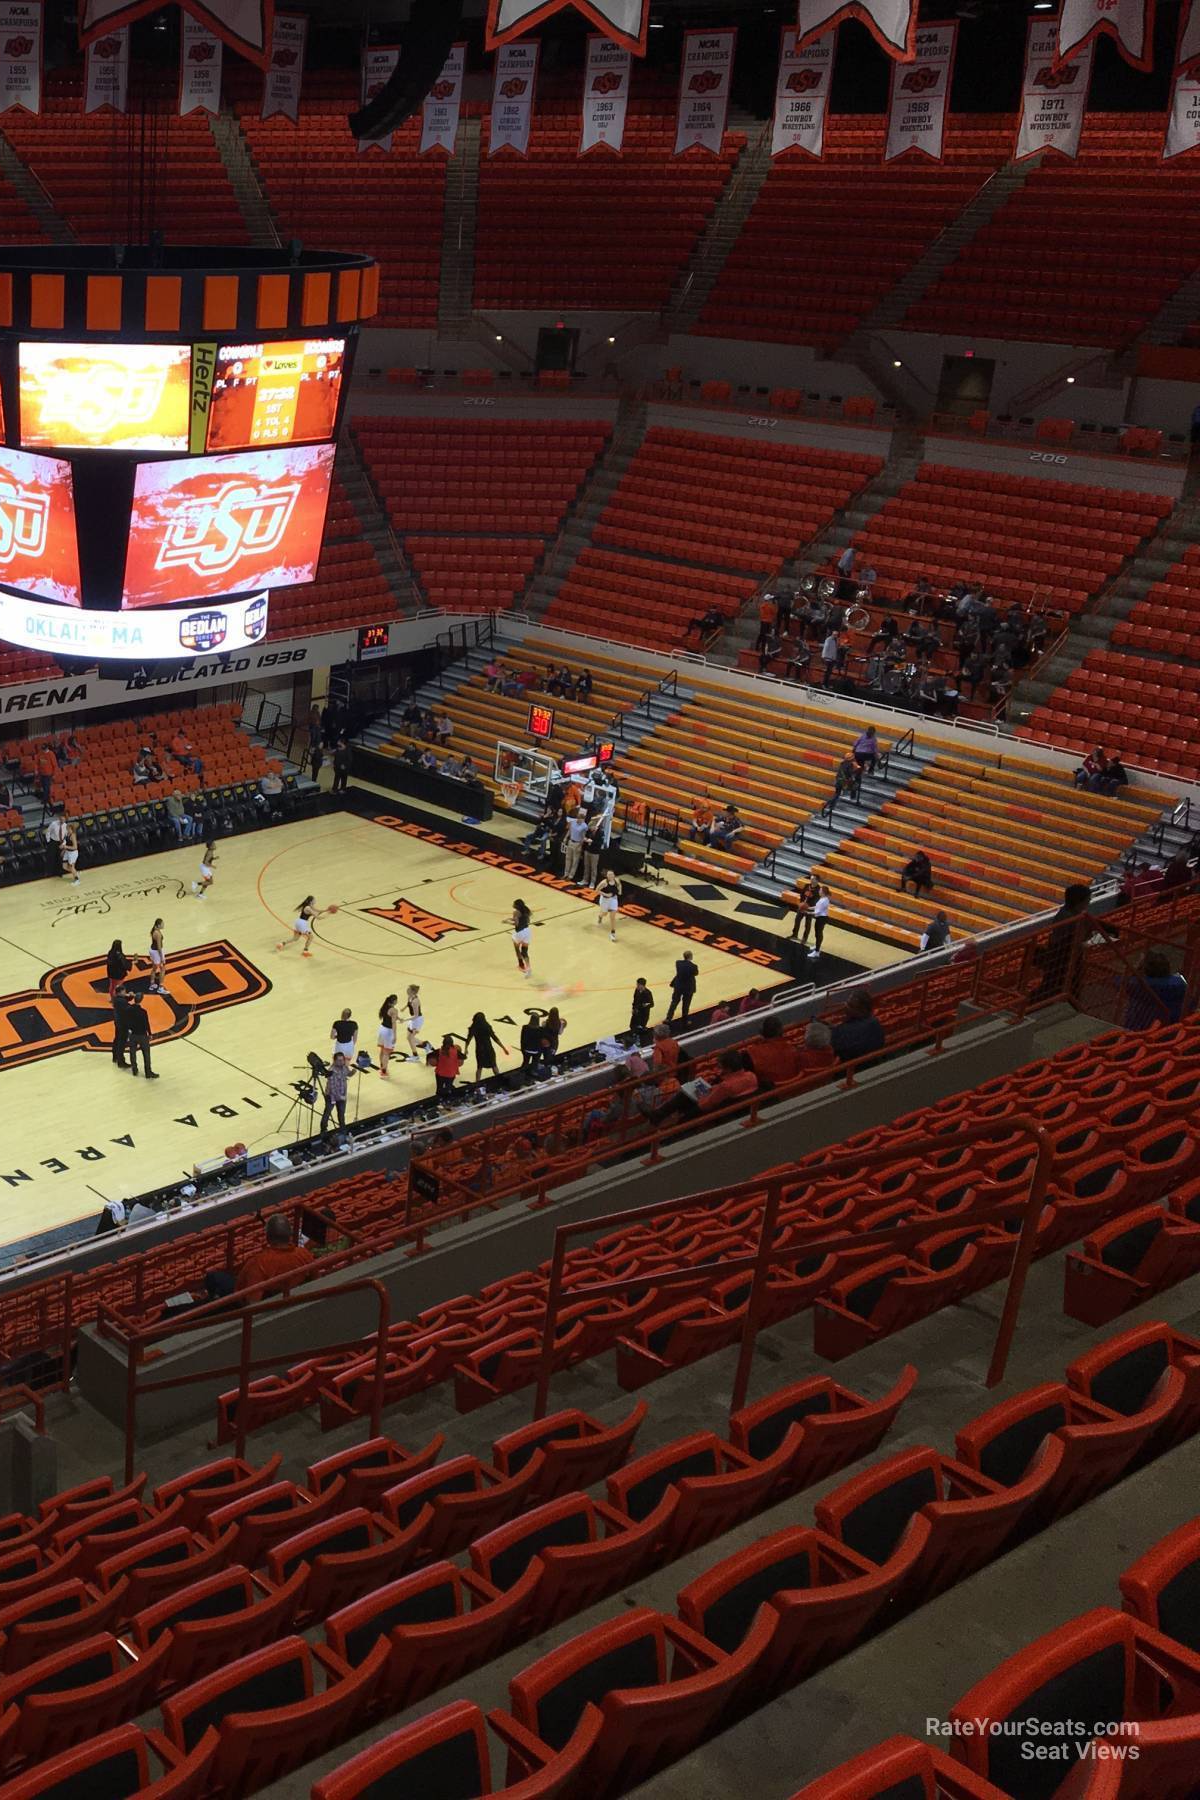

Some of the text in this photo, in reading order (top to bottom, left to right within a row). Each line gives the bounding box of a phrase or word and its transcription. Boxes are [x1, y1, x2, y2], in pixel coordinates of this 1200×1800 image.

[9, 7, 29, 16] NCAA
[698, 40, 720, 49] NCAA
[509, 49, 526, 57] NCAA
[590, 53, 628, 63] CHAMPIONS
[688, 51, 729, 61] CHAMPIONS
[688, 70, 723, 93] OSU
[785, 68, 823, 93] OSU
[901, 67, 941, 93] OSU
[597, 103, 613, 111] 1963
[693, 103, 711, 111] 1964
[790, 102, 811, 112] 1966
[907, 102, 929, 112] 1968
[1041, 100, 1065, 109] 1971
[785, 114, 813, 123] COWBOY
[902, 115, 931, 124] COWBOY
[1034, 113, 1069, 122] COWBOY
[1030, 122, 1071, 130] WRESTLING
[193, 347, 214, 413] Hertz
[1030, 452, 1068, 464] 208
[155, 481, 300, 575] OSU
[182, 618, 227, 636] BEDLAM
[257, 648, 308, 668] 1938
[374, 815, 782, 967] OKLAHOMA STATE
